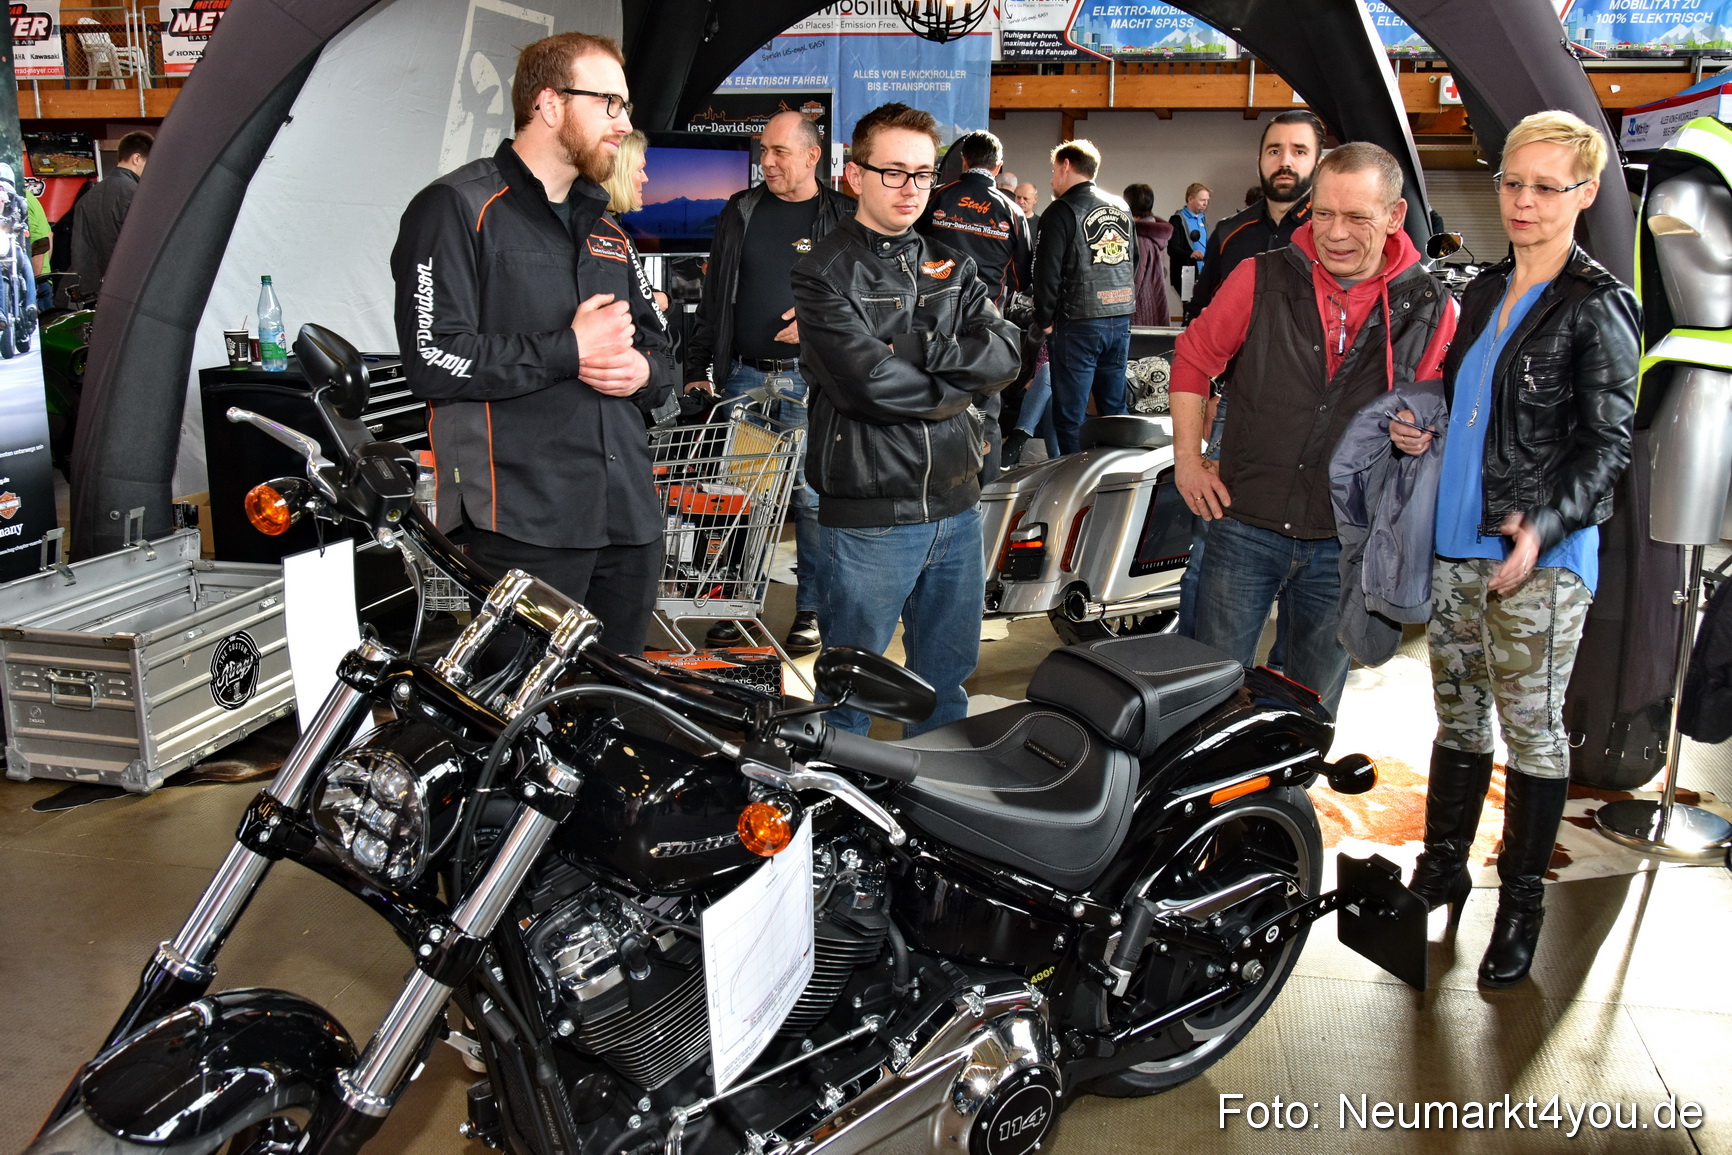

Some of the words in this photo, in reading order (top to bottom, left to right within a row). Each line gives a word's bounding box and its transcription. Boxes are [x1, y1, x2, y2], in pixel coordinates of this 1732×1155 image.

[1681, 0, 1701, 9] ZU
[1110, 18, 1152, 29] MACHT
[1154, 17, 1195, 28] SPASS
[1596, 12, 1627, 24] 100%
[1629, 11, 1714, 24] ELEKTRISCH
[805, 20, 834, 29] Places!
[840, 20, 877, 29] Emission
[878, 20, 899, 29] Free.
[1003, 32, 1031, 40] Ruhiges
[1032, 32, 1059, 40] Fahren,
[808, 39, 826, 50] EASY
[1045, 48, 1078, 56] Fahrspaß
[853, 70, 880, 79] ALLES
[881, 70, 900, 79] VON
[901, 69, 967, 80] E-(KICK)ROLLER
[735, 76, 790, 86] ELEKTRISCH
[792, 75, 828, 85] FAHREN
[867, 82, 881, 91] BIS
[882, 81, 952, 91] E-TRANSPORTER
[958, 196, 992, 214] Staff
[932, 218, 982, 232] Harley-Davidson
[982, 226, 1010, 239] Nürnberg
[228, 642, 248, 655] CUSTOM
[999, 1105, 1046, 1142] 114
